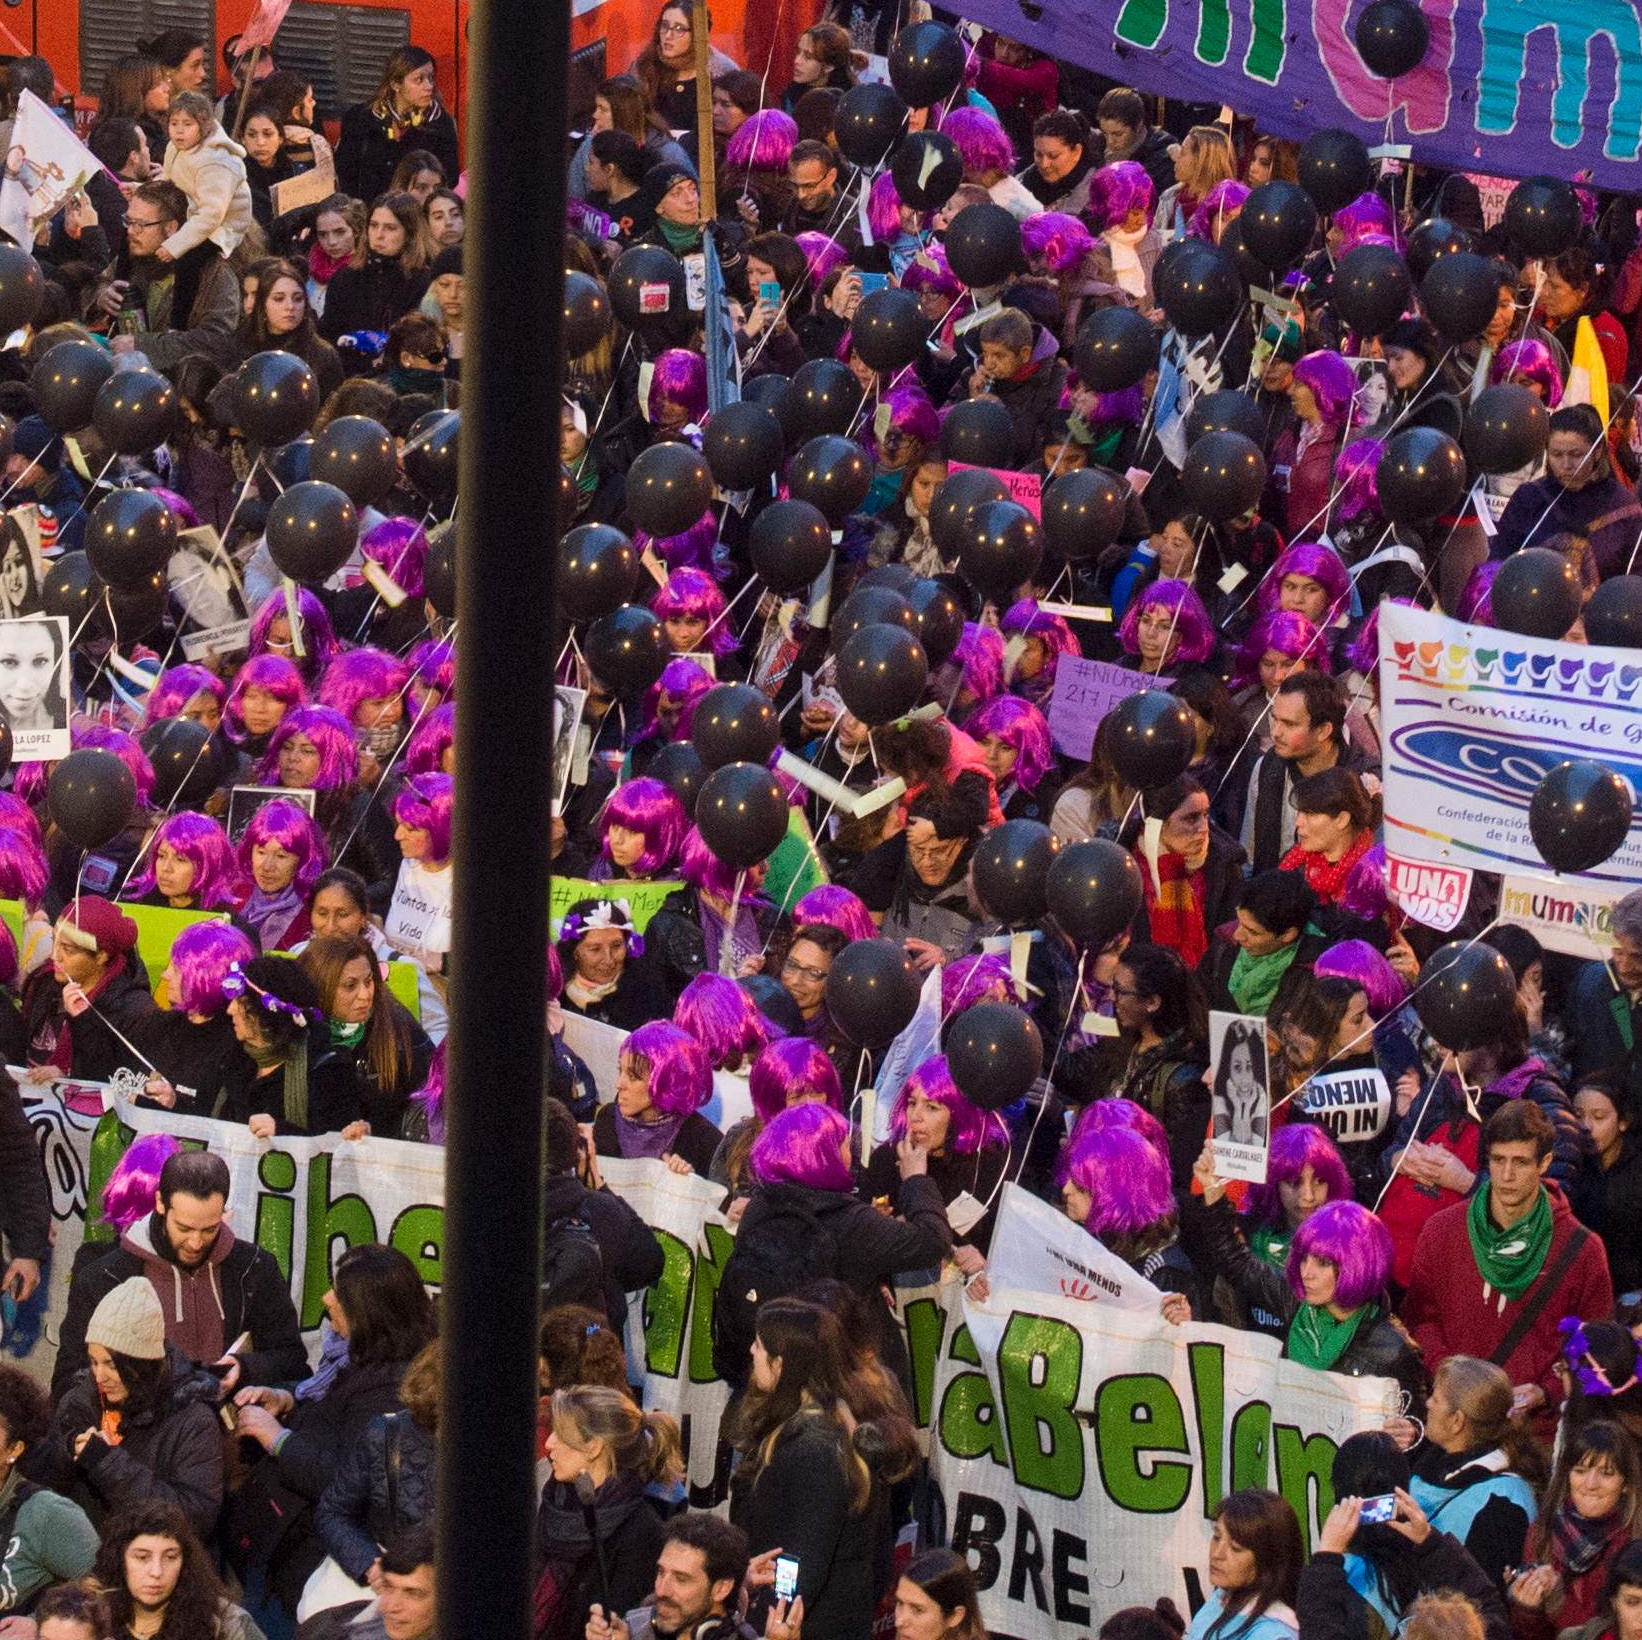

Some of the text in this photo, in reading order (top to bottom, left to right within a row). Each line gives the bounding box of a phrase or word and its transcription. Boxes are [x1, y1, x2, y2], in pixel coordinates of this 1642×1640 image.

[1065, 683, 1101, 707] 217
[1448, 696, 1571, 730] Comisión
[1580, 713, 1612, 735] de
[27, 733, 53, 747] LOPEZ
[1485, 828, 1502, 842] de
[1506, 829, 1517, 843] la
[397, 920, 424, 941] Vida
[1353, 1107, 1378, 1132] NI
[1087, 1268, 1123, 1299] MENOS
